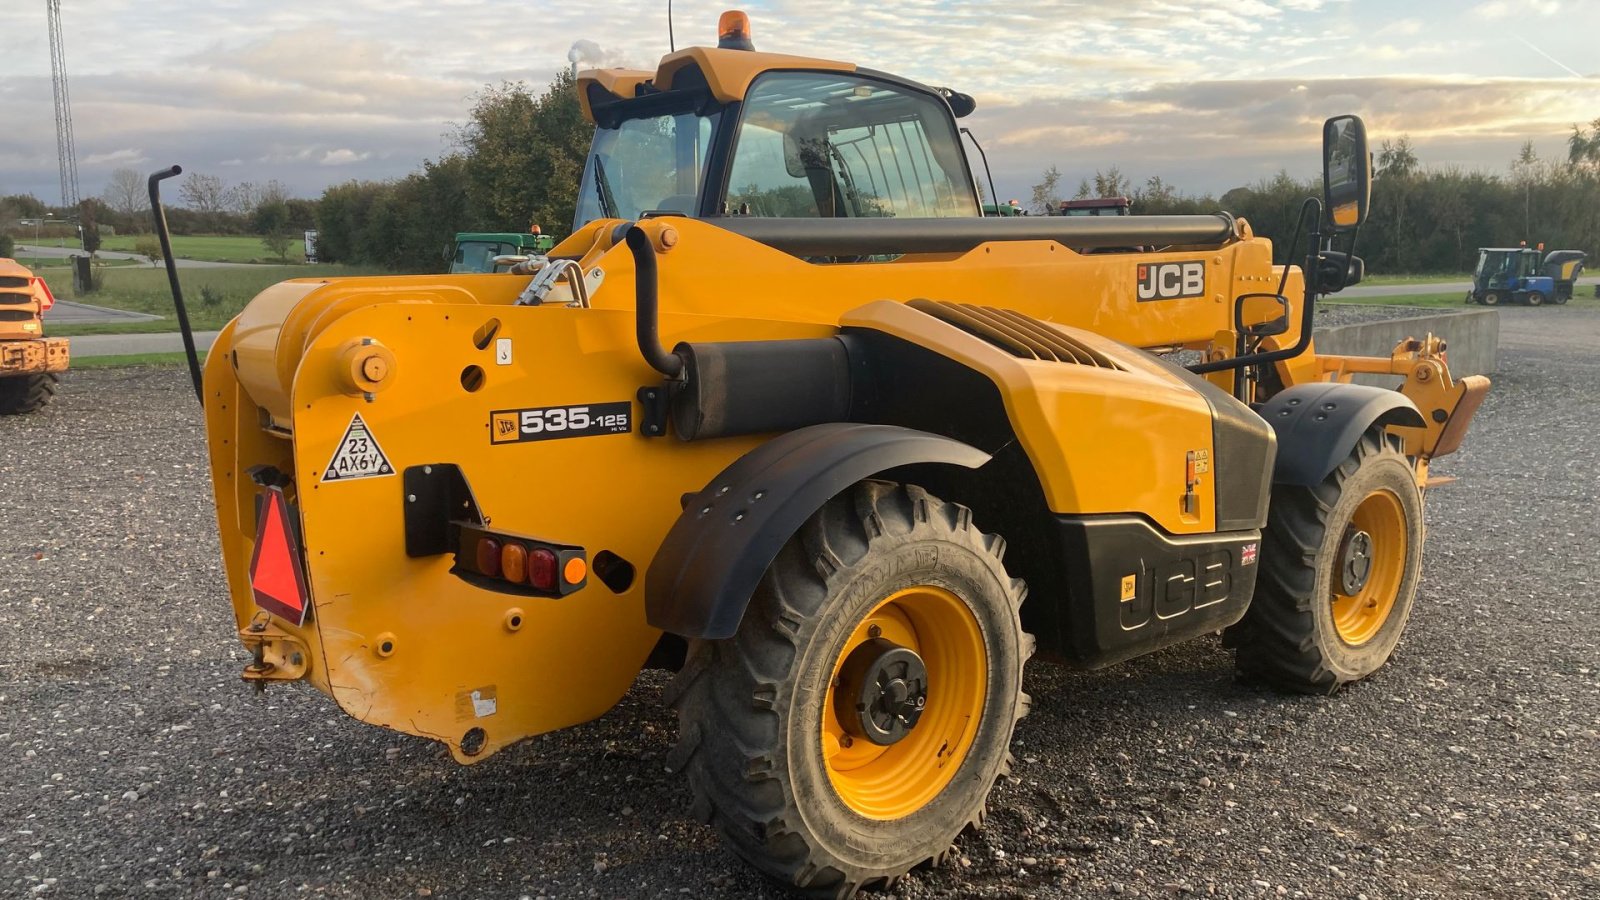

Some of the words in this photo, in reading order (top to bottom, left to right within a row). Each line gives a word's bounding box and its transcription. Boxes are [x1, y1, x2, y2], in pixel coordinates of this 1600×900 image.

[1138, 263, 1204, 299] JCB
[500, 420, 515, 434] JCB
[521, 407, 627, 434] 535-125
[348, 438, 368, 454] 23
[339, 454, 378, 473] AX6Y
[1120, 550, 1232, 631] JCB
